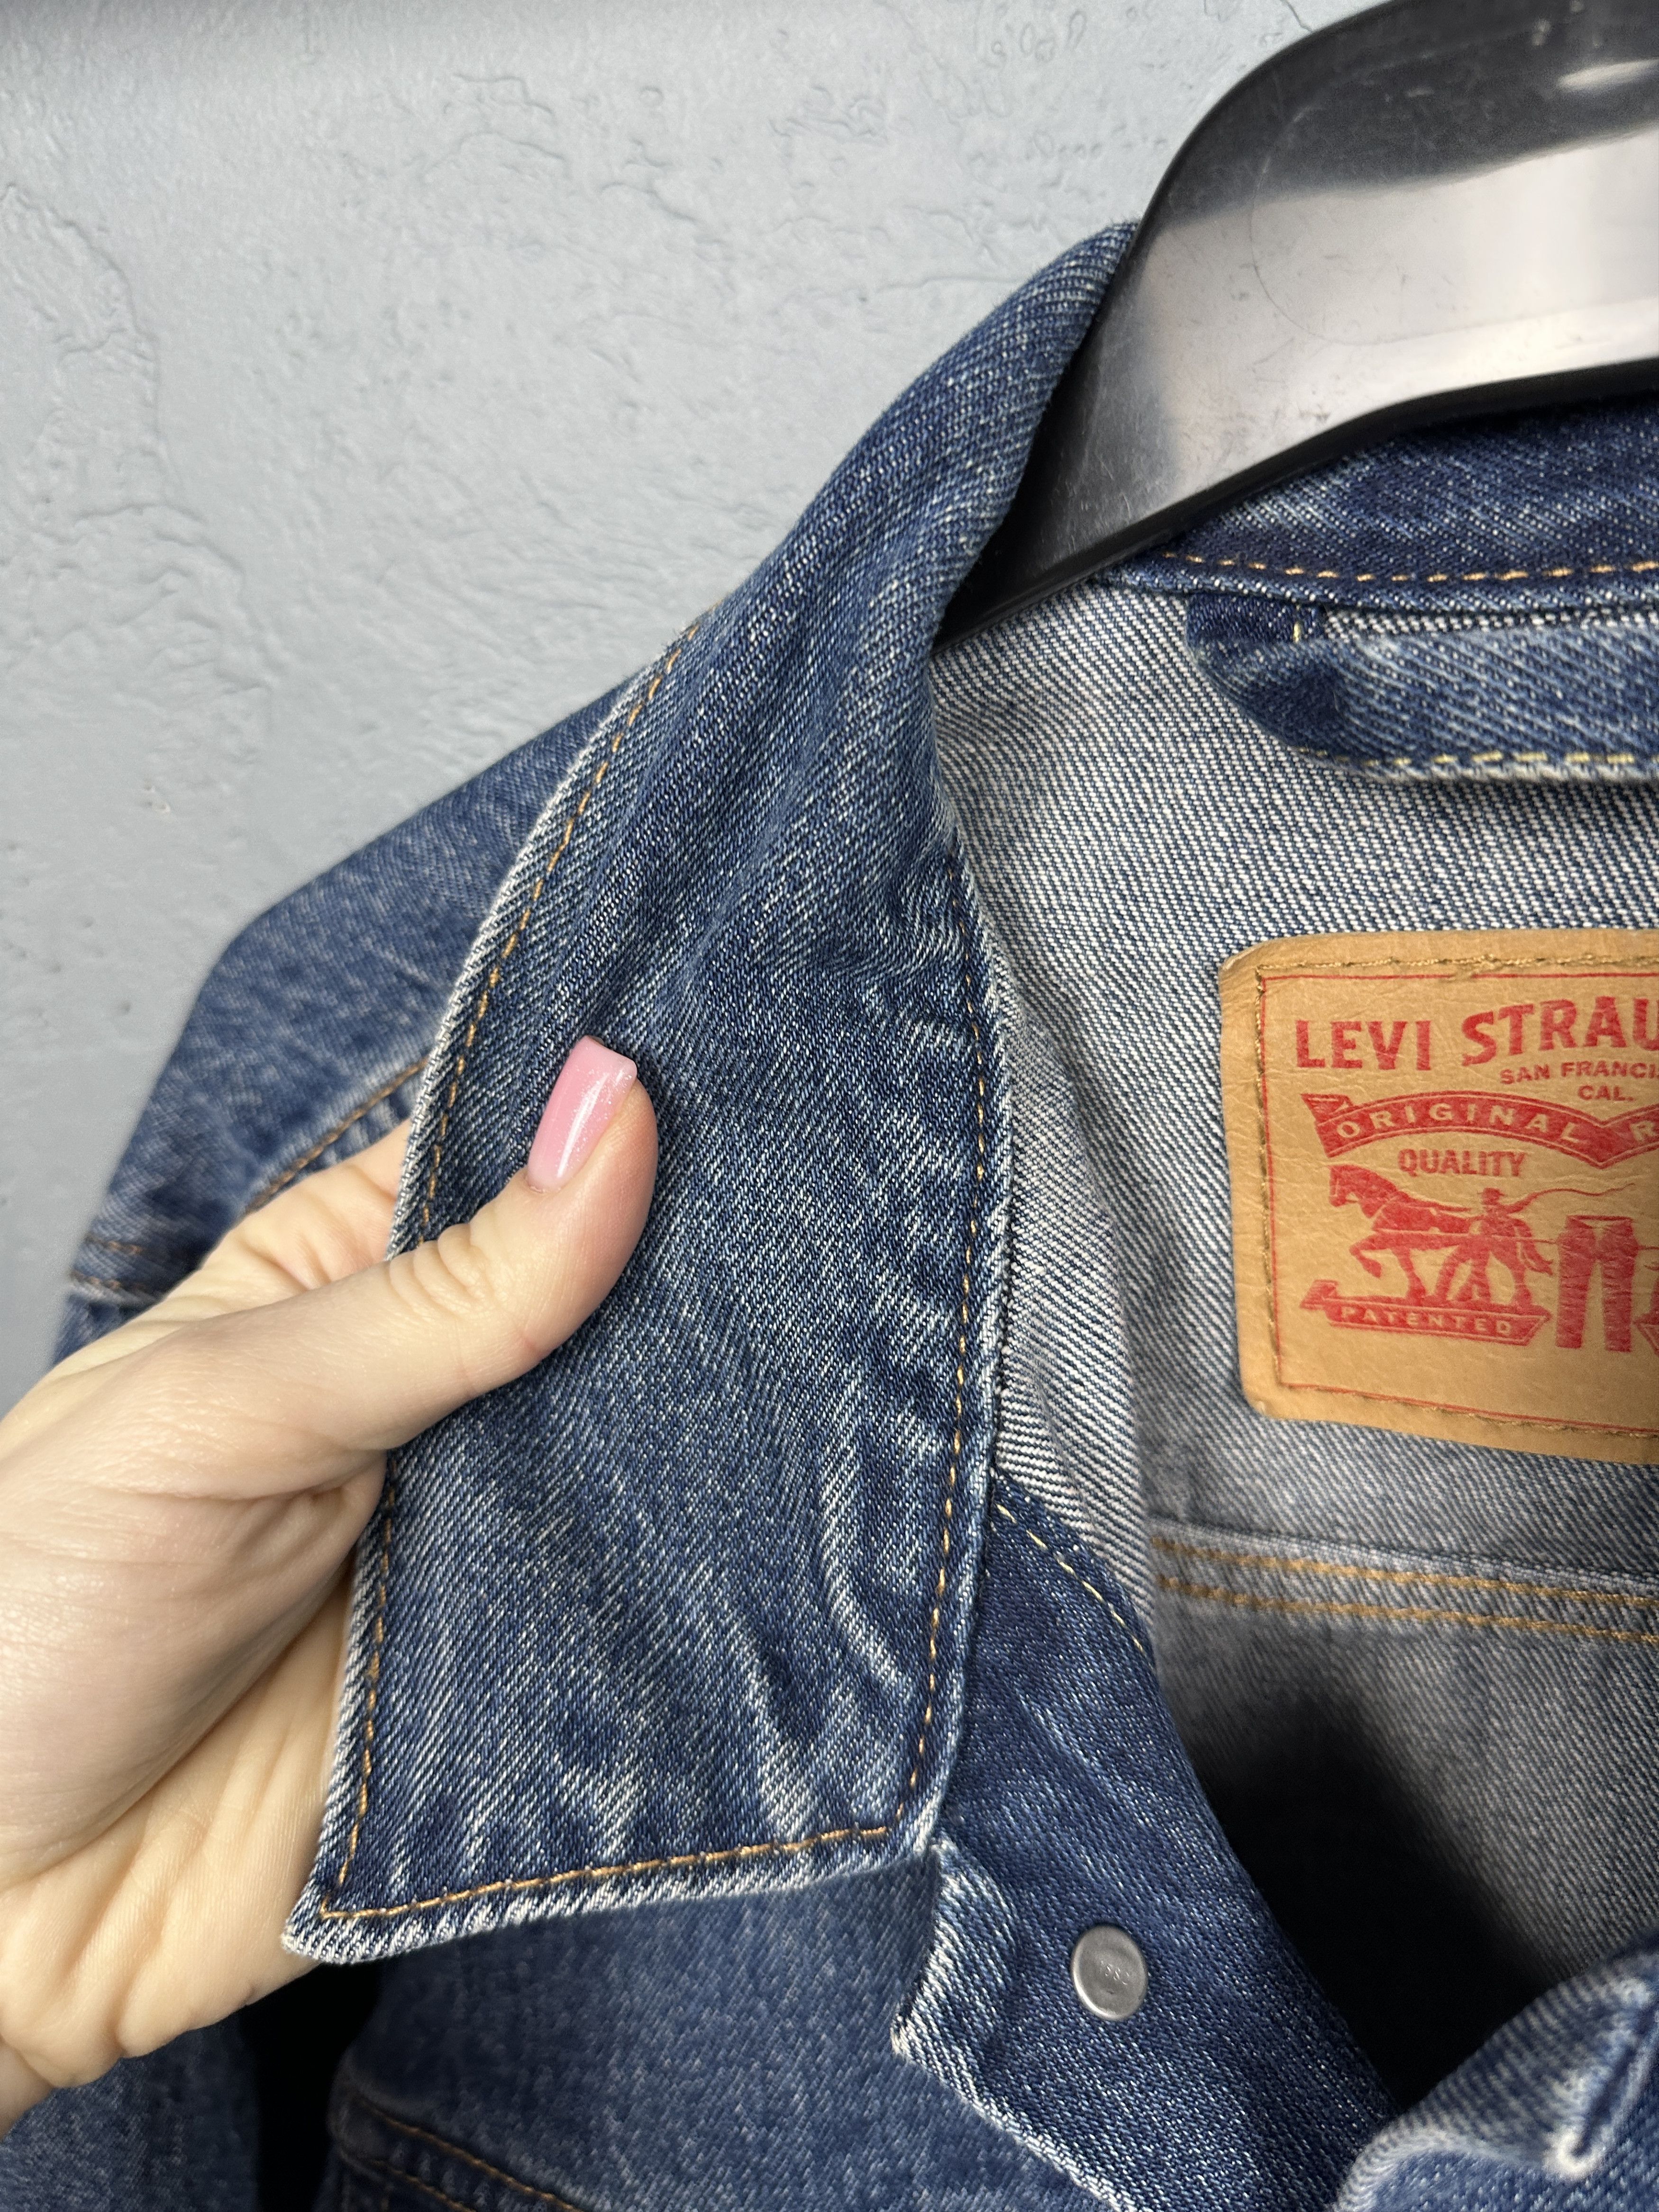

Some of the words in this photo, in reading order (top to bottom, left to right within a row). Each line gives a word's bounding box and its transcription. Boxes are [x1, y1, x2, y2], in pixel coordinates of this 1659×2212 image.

[1295, 1020, 1432, 1071] LEVI
[1499, 1064, 1550, 1085] SAN
[1561, 1060, 1659, 1079] FRANCI
[1577, 1084, 1634, 1102] CAL.
[1336, 1102, 1579, 1144] ORIGINAL
[1397, 1148, 1527, 1177] QUALITY
[1340, 1306, 1512, 1337] PATENTED
